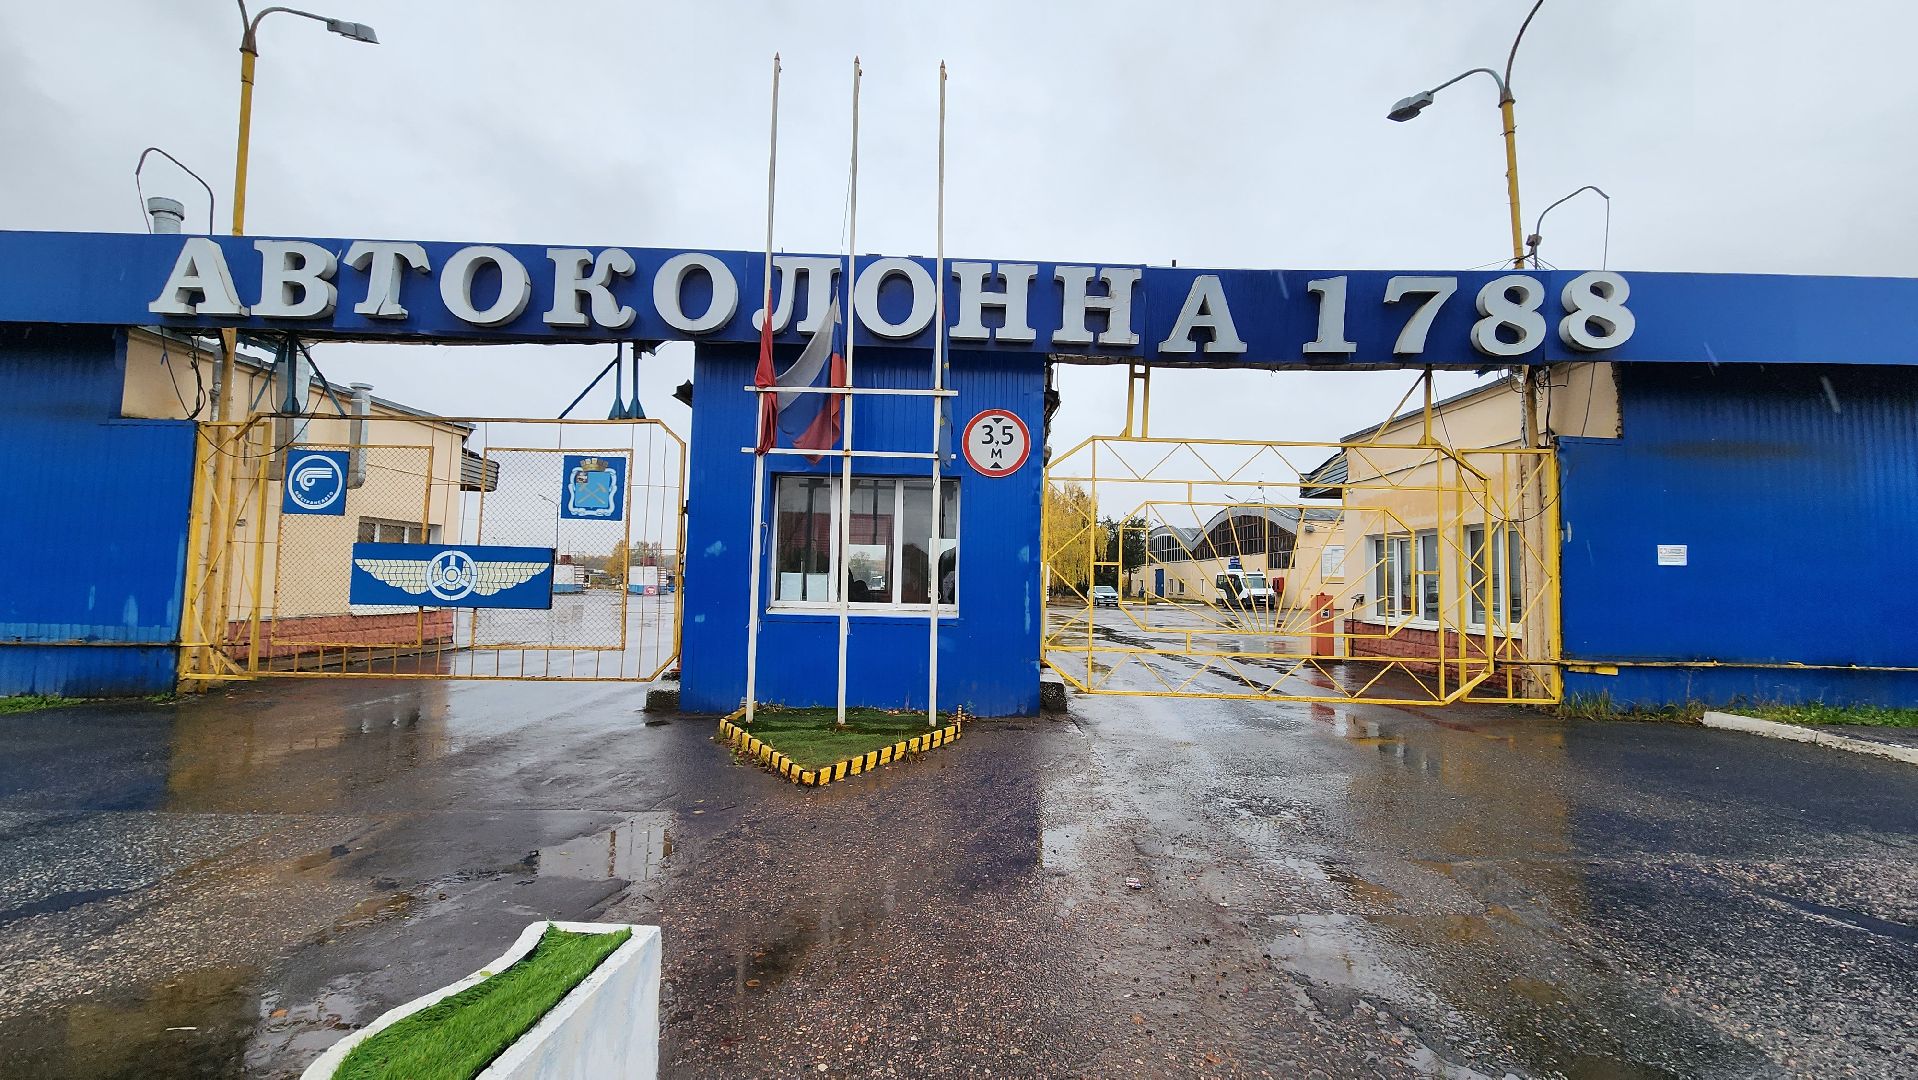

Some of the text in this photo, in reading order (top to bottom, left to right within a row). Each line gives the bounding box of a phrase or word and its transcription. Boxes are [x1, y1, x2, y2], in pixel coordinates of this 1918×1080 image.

[149, 238, 1636, 357] АВТОКОЛОННА 1788
[981, 424, 1014, 447] 3,5
